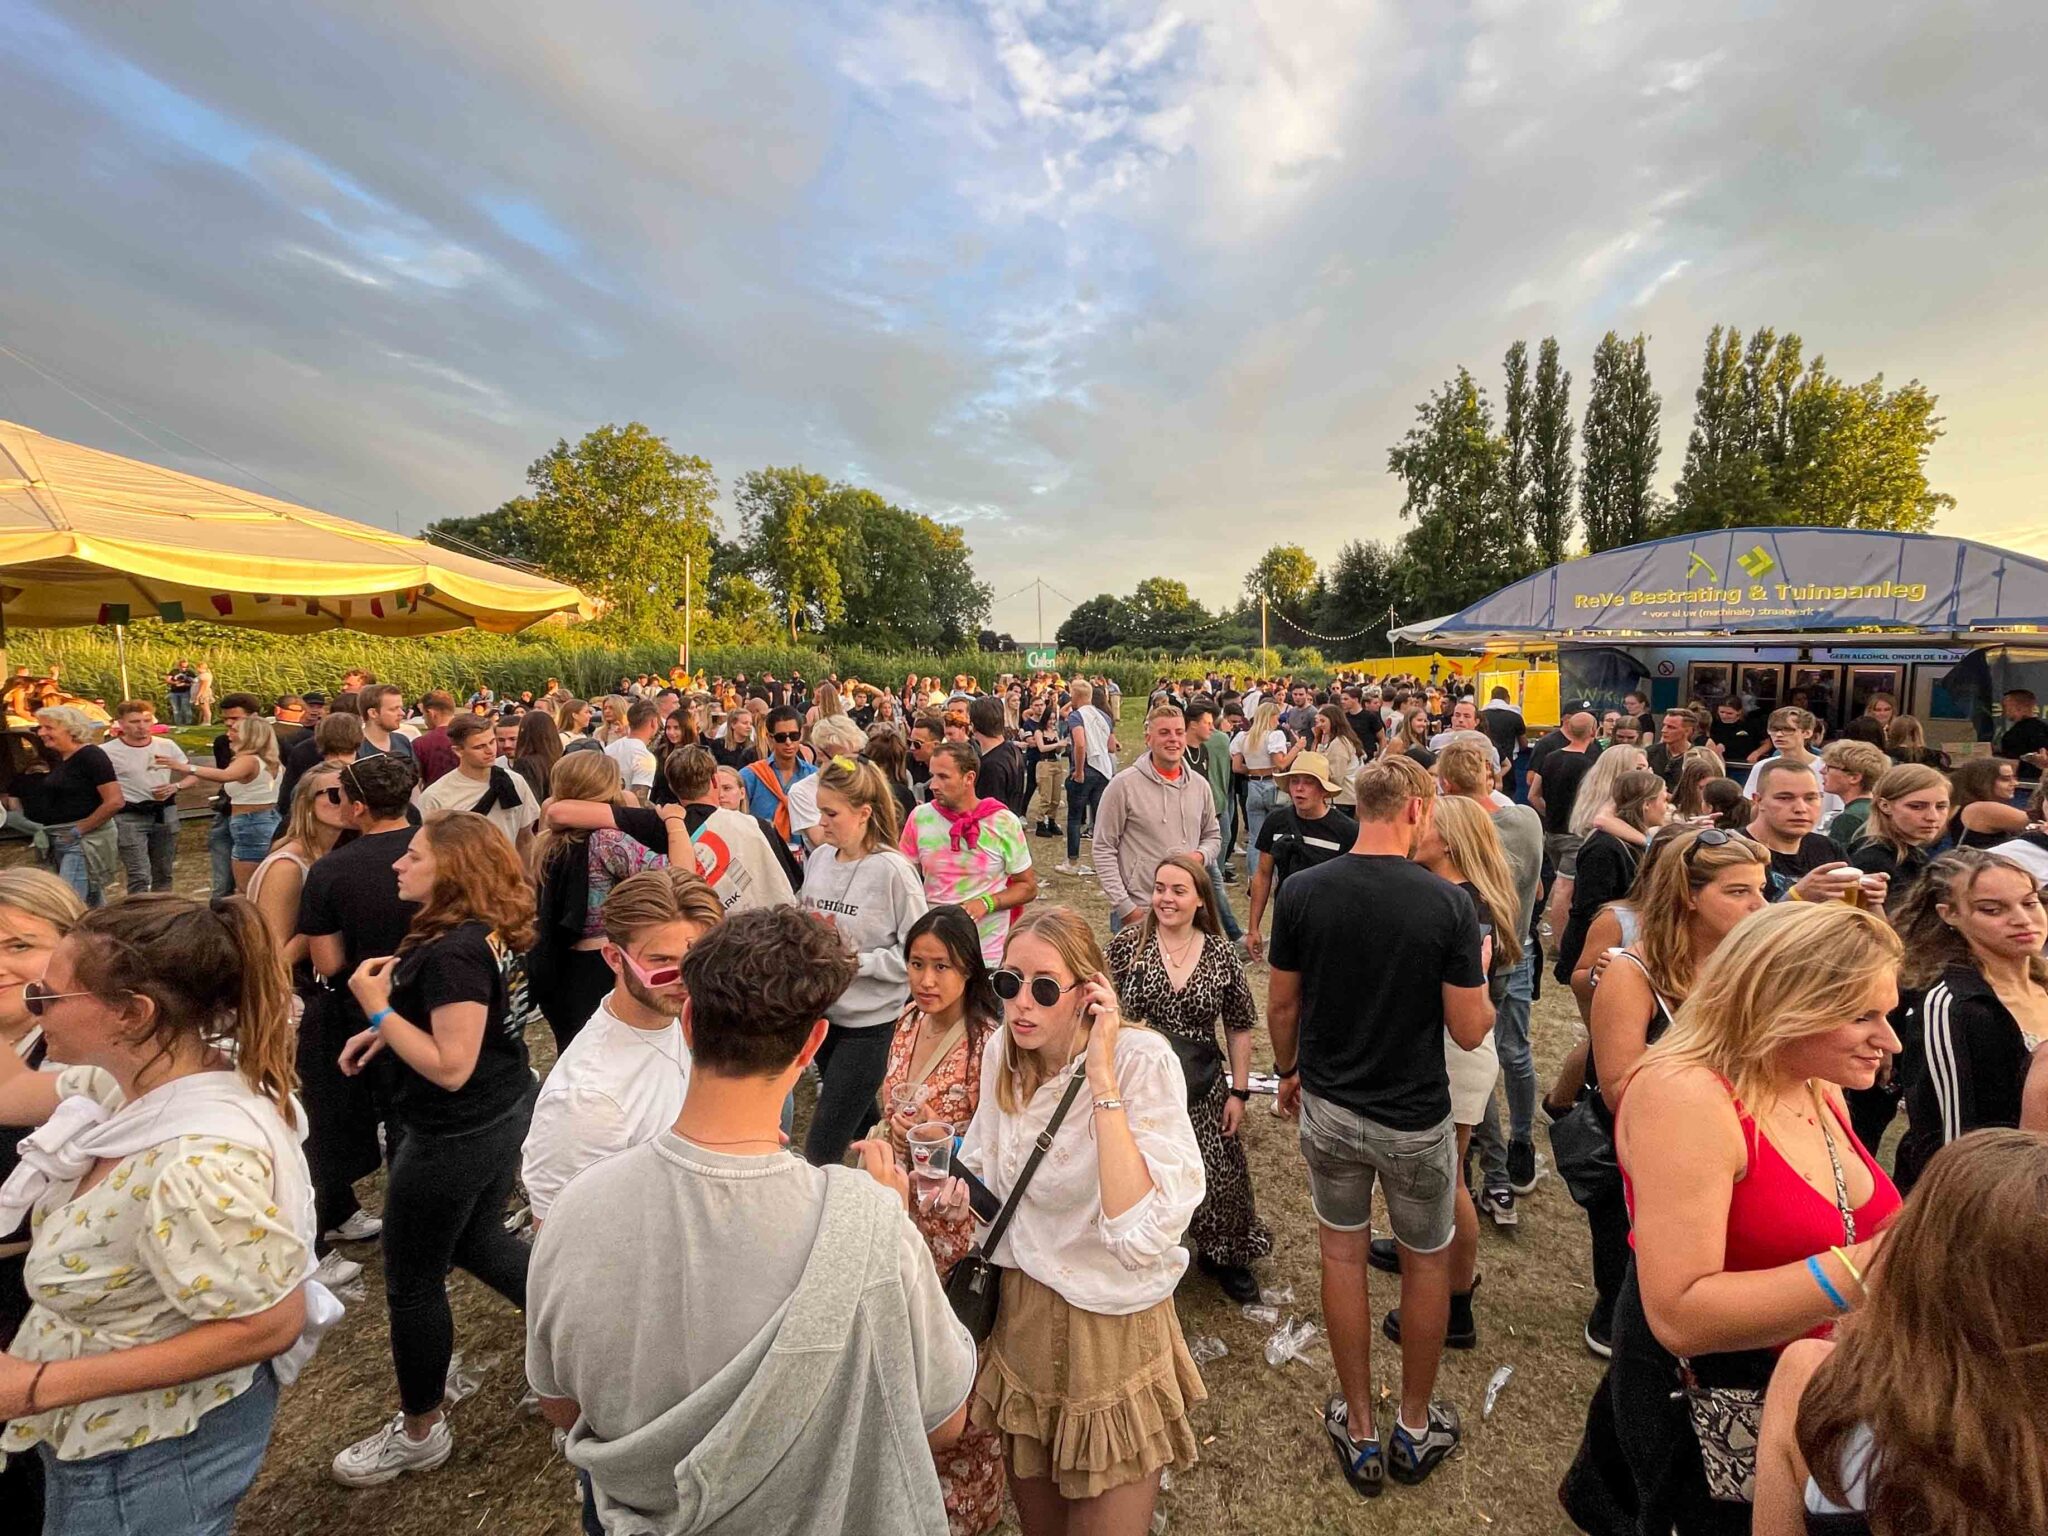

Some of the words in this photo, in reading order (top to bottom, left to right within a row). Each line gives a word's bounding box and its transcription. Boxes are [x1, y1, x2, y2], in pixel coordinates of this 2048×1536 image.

[1575, 594, 1624, 608] ReVe
[1630, 588, 1742, 605] Bestrating
[1749, 585, 1768, 601] &
[1775, 580, 1927, 602] Tuinaanleg
[1672, 609, 1681, 617] al
[1923, 653, 1936, 661] DE
